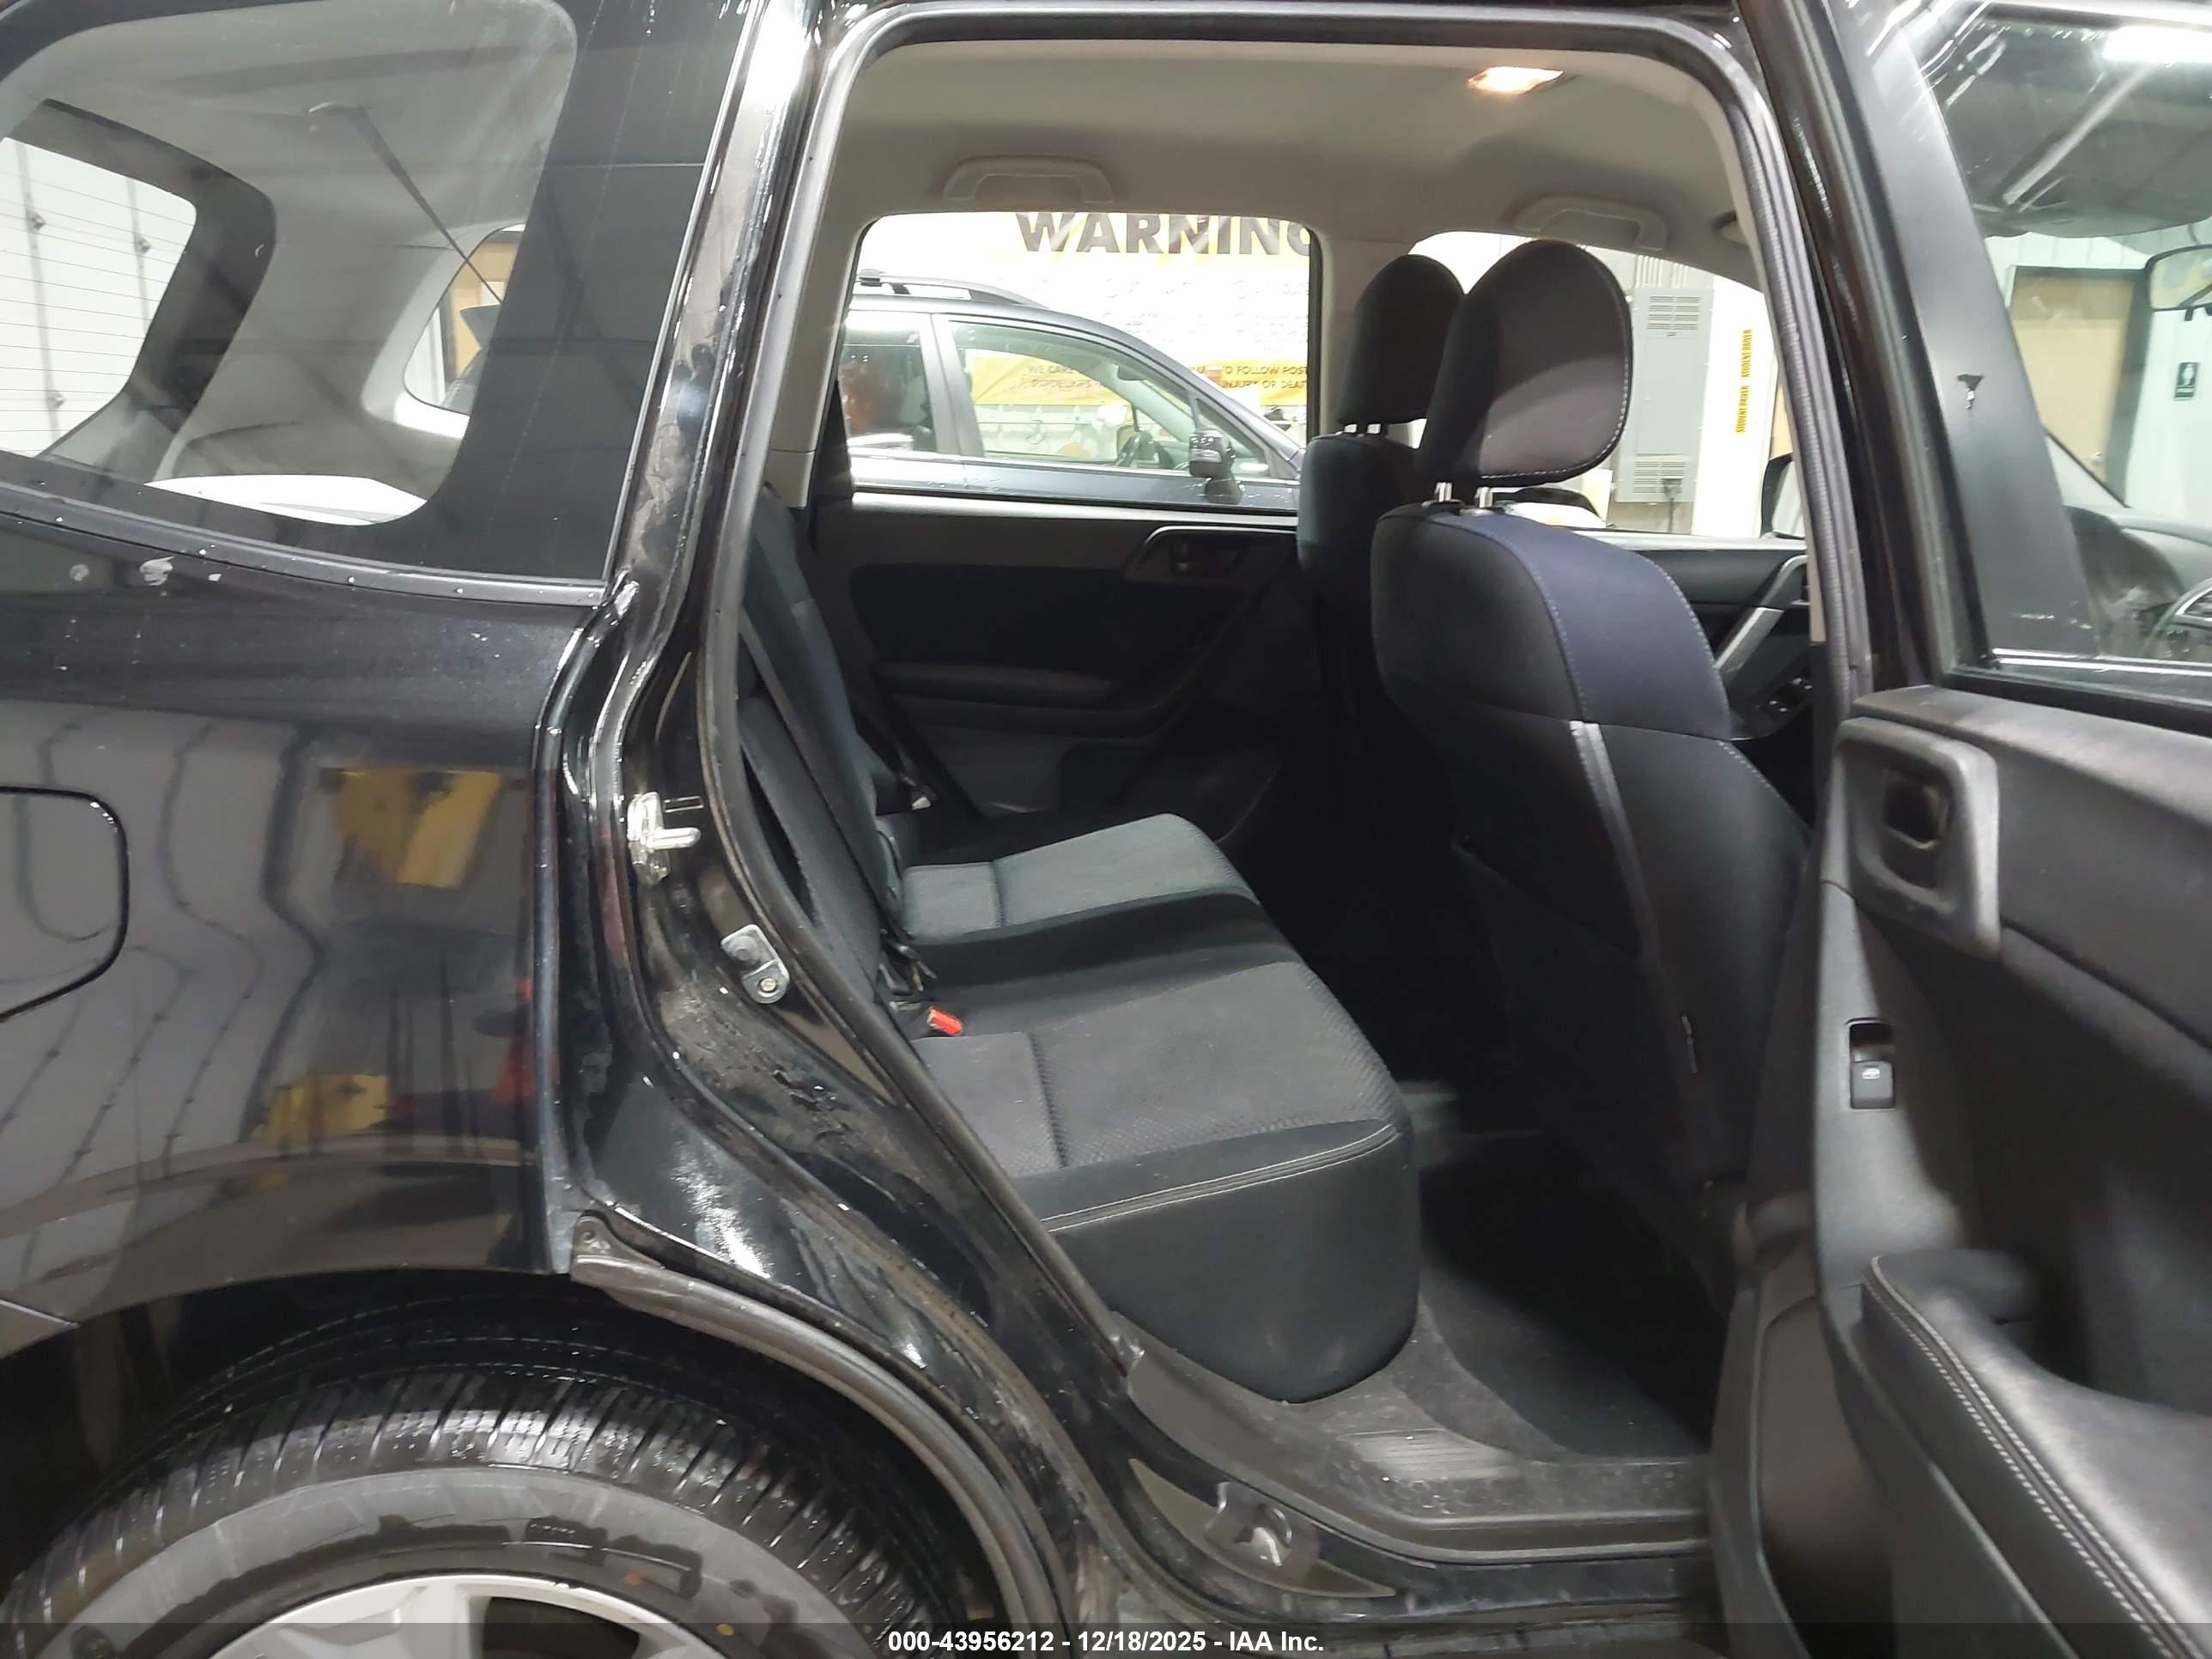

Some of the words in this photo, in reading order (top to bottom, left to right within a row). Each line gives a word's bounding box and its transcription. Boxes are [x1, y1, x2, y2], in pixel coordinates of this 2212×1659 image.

[1741, 330, 1752, 351] DRIVER
[1237, 366, 1279, 374] FOLLOW
[1741, 353, 1751, 378] STUDENT
[1738, 386, 1749, 407] DRIVER
[1736, 408, 1747, 433] STUDENT
